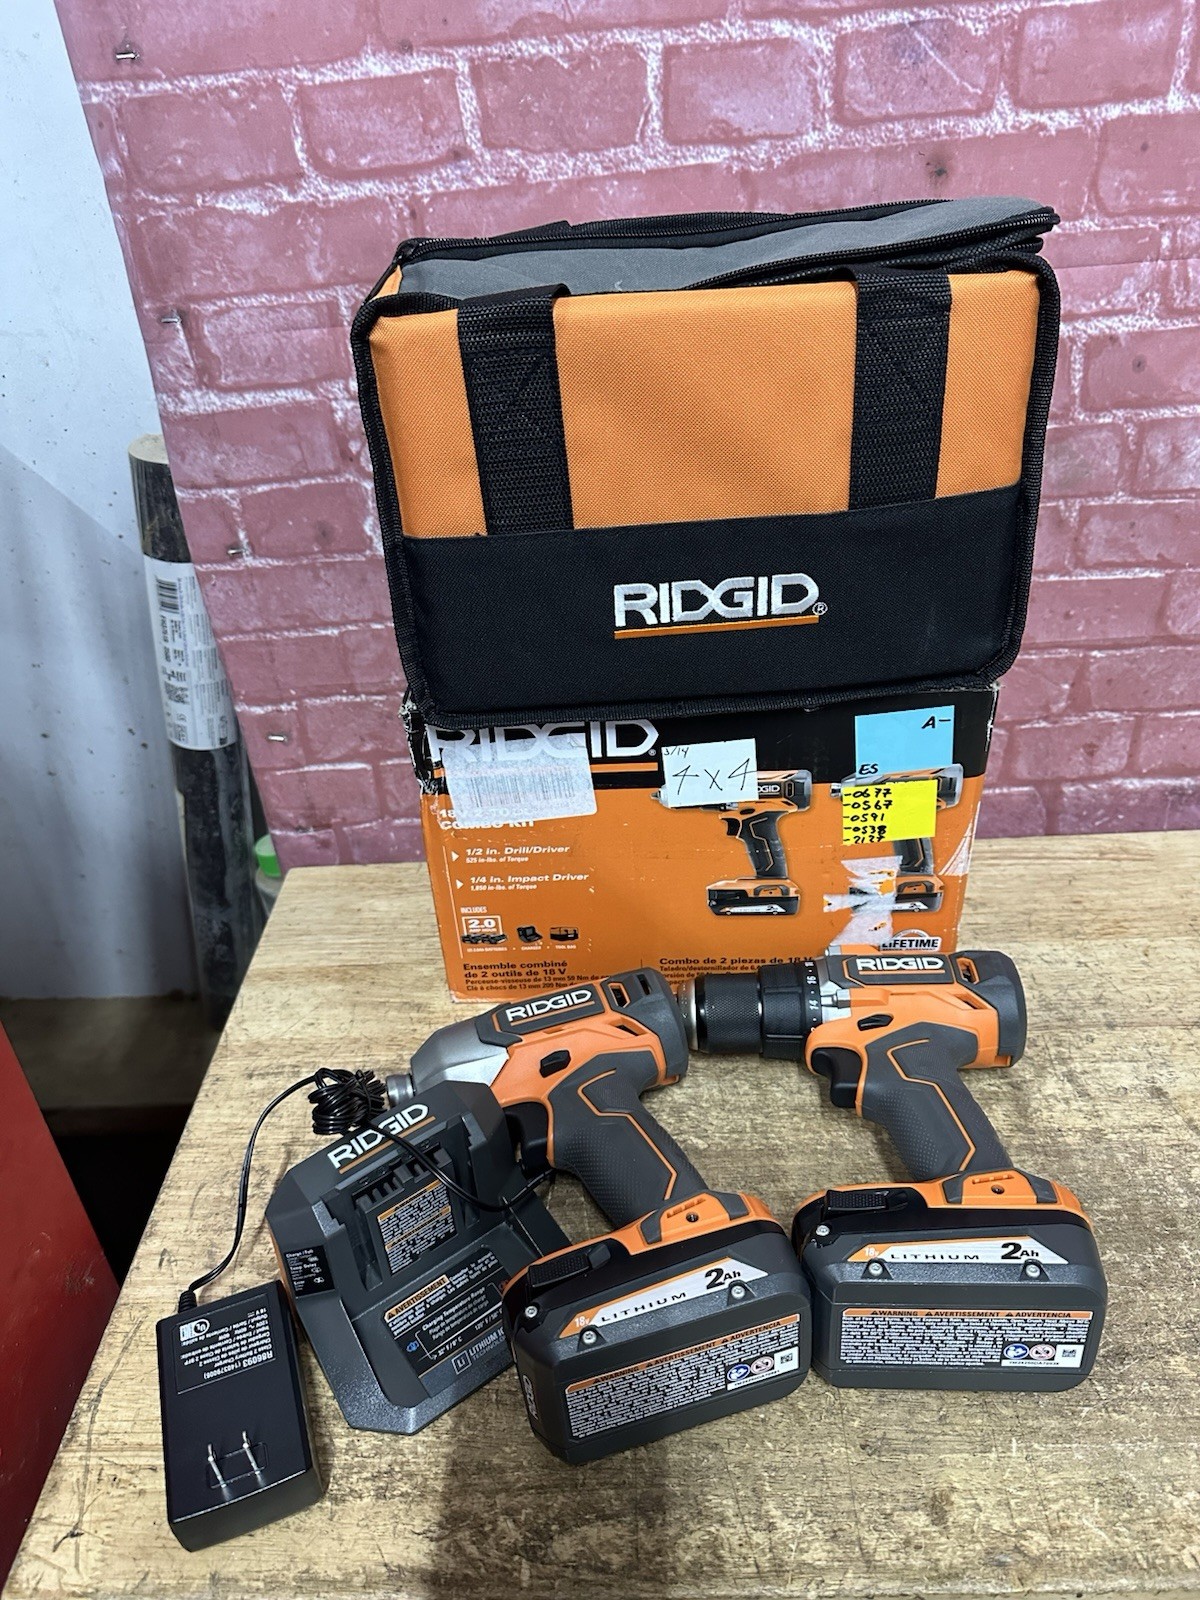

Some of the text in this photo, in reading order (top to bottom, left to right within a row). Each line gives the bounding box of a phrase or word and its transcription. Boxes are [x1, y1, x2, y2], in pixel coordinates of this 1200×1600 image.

[613, 572, 820, 628] RIDGID
[663, 747, 689, 758] 3/14
[672, 765, 700, 796] 4
[728, 758, 757, 791] 4
[858, 763, 879, 776] ES
[466, 846, 570, 856] 1/2 in. Drill/Driver
[470, 876, 486, 884] 1/4
[508, 874, 550, 884] Impact
[552, 873, 589, 881] Driver
[468, 919, 496, 929] 2.0
[463, 959, 567, 970] Ensemble combiné
[659, 957, 699, 965] Combo
[731, 956, 766, 965] piezas
[855, 957, 944, 971] RIDGID
[491, 969, 522, 977] outils
[505, 989, 593, 1022] RIDGID
[327, 1103, 429, 1170] RIDGID
[1001, 1242, 1040, 1260] 2Ah
[702, 1262, 742, 1289] 2Ah
[601, 1291, 686, 1322] LITHIUM
[241, 1350, 273, 1366] R86093
[600, 1365, 639, 1381] WARNING
[729, 1320, 780, 1341] ADVERTENCIA
